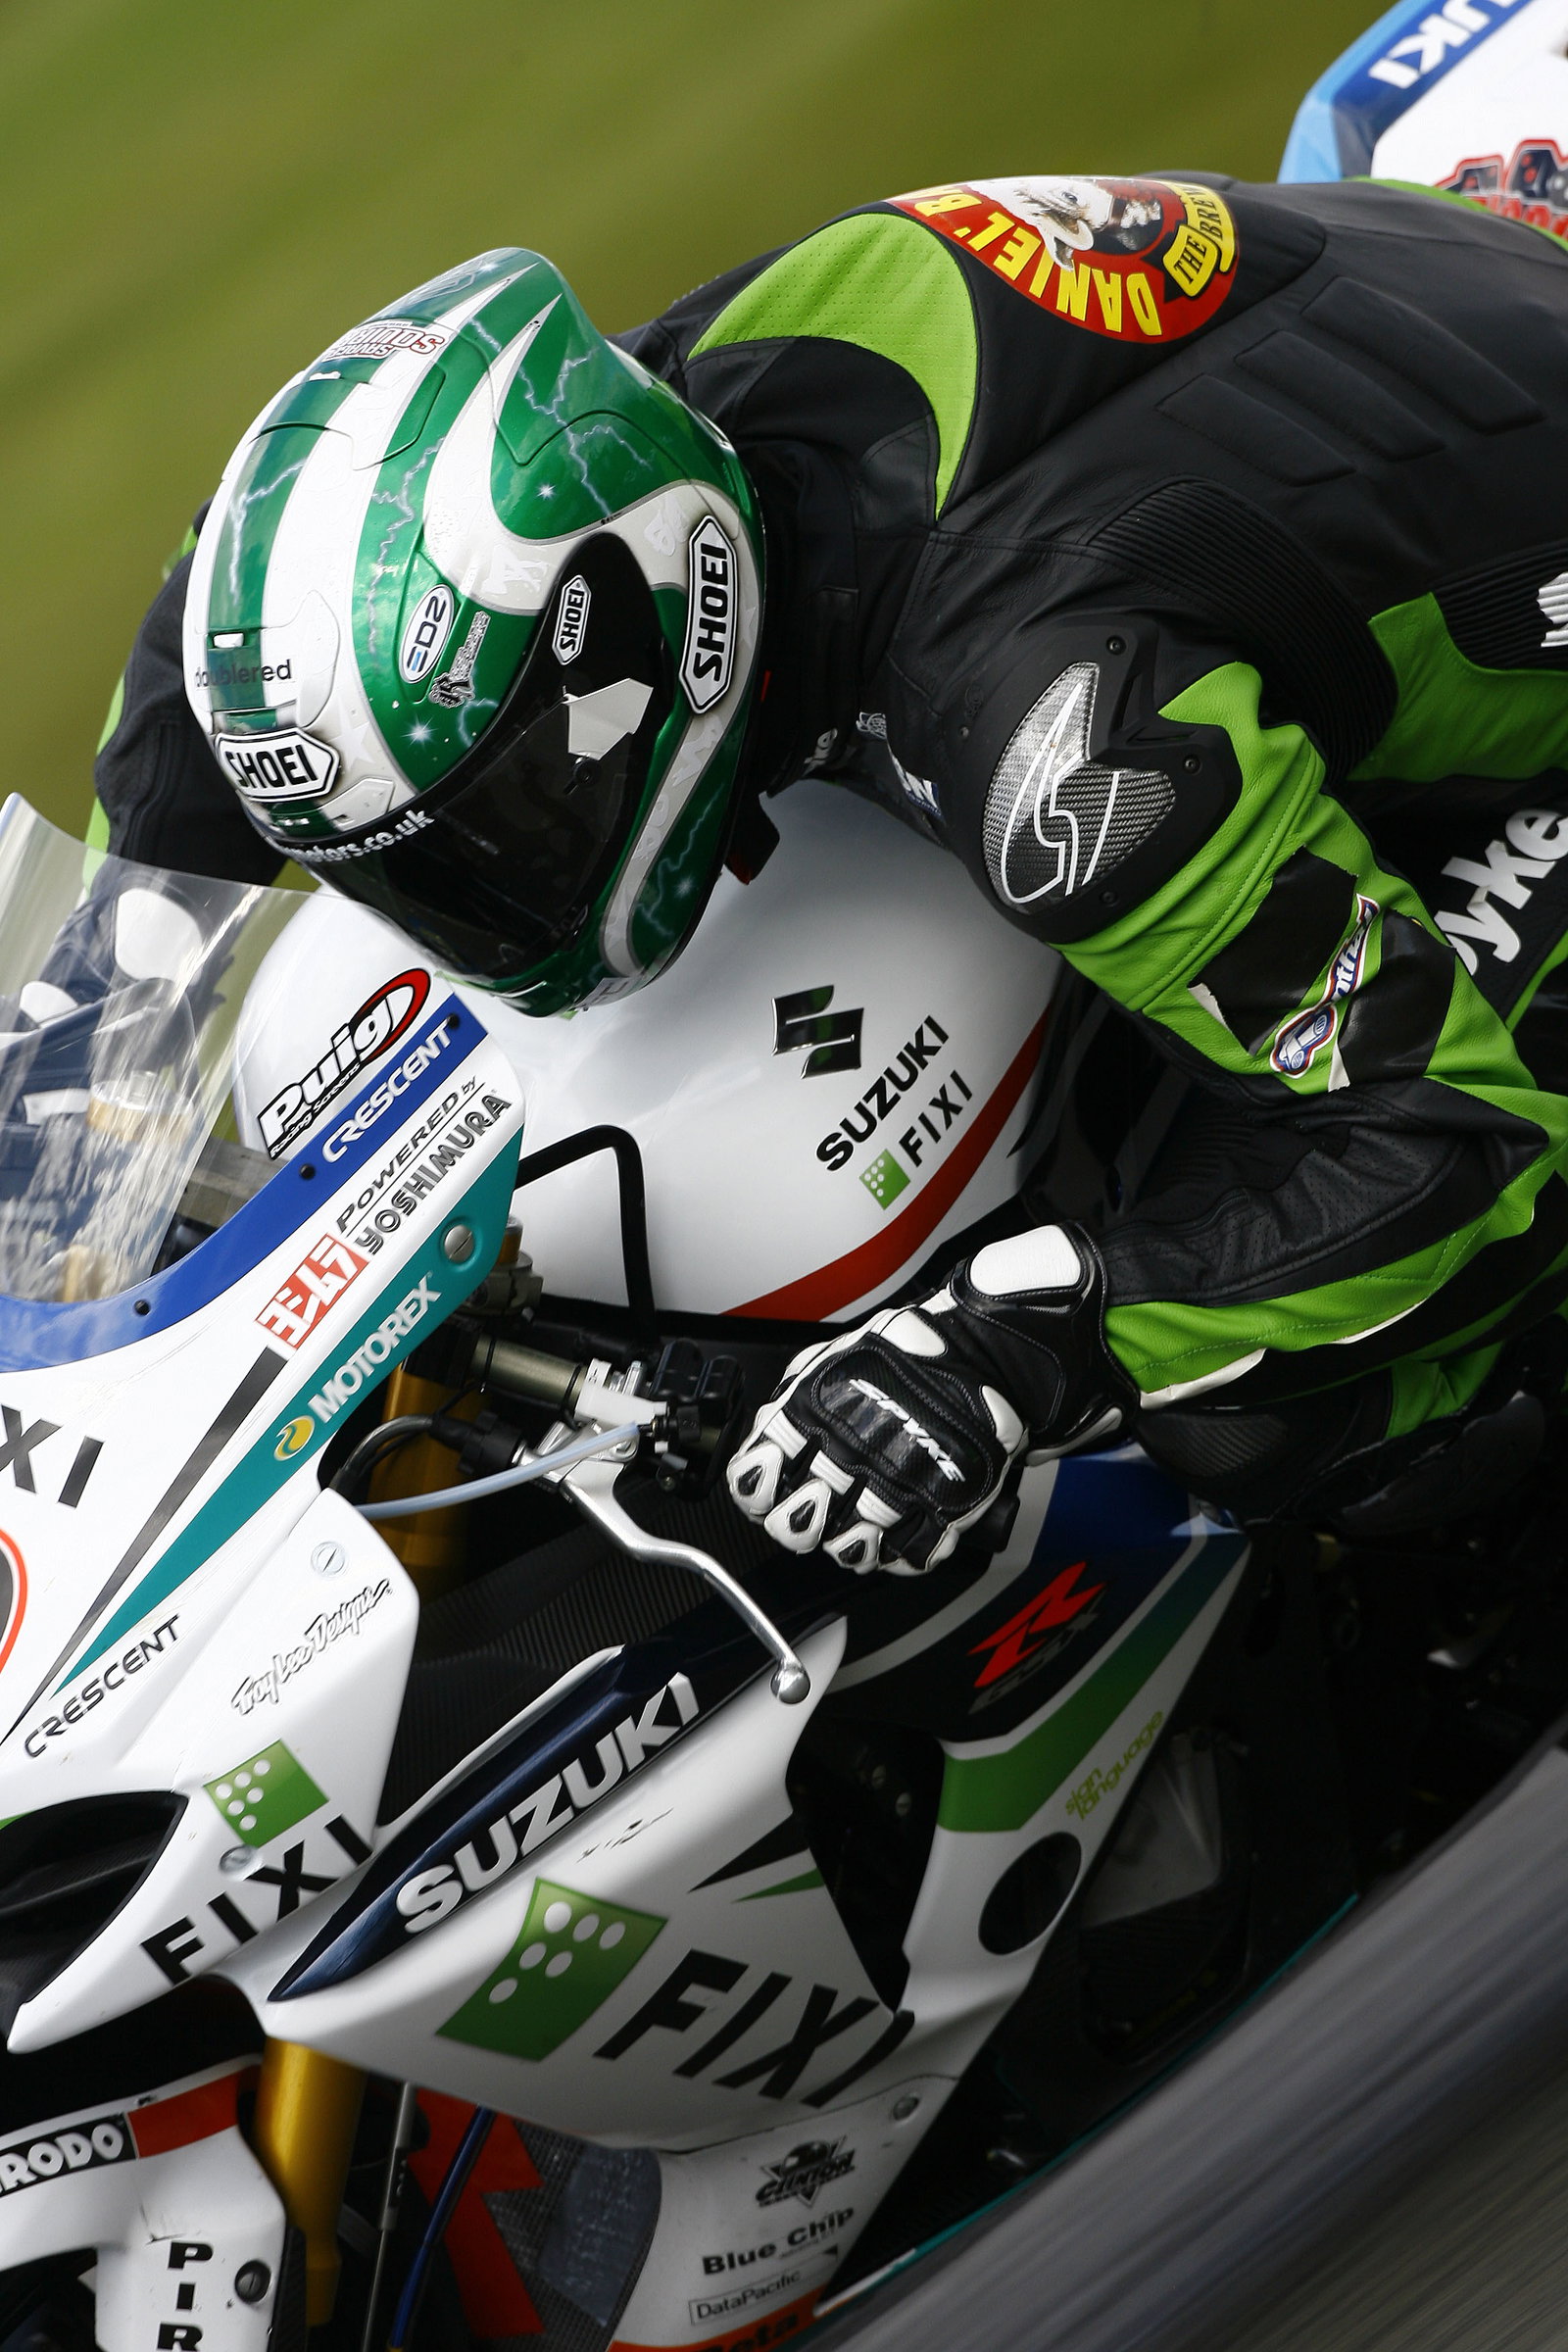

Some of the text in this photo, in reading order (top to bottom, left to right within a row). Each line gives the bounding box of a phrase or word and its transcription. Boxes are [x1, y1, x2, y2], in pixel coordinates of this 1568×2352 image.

[1173, 235, 1207, 285] THE
[560, 588, 585, 653] SHOEI
[693, 542, 728, 682] SHOEI
[224, 743, 318, 790] SHOEI
[257, 978, 419, 1149] Puig
[314, 1062, 362, 1113] Screens
[321, 1016, 453, 1163] CRESCENT
[815, 1014, 950, 1172] SUZUKI
[898, 1069, 973, 1168] FIXI
[335, 1075, 476, 1235] POWERED by
[354, 1094, 513, 1256] YOSHIMURA
[307, 1274, 442, 1424] MOTOREX
[24, 1613, 181, 1758] CRESCENT
[230, 1578, 393, 1716] Troy Lee Designs
[395, 1670, 700, 1935] SUZUKI
[139, 1813, 374, 1986] FIXI
[591, 1946, 915, 2110] FIXI
[0, 2122, 124, 2195] RODO
[696, 2271, 802, 2320] DataPacific
[702, 2242, 777, 2276] Blue
[787, 2207, 855, 2246] Chip
[694, 2312, 800, 2352] eta
